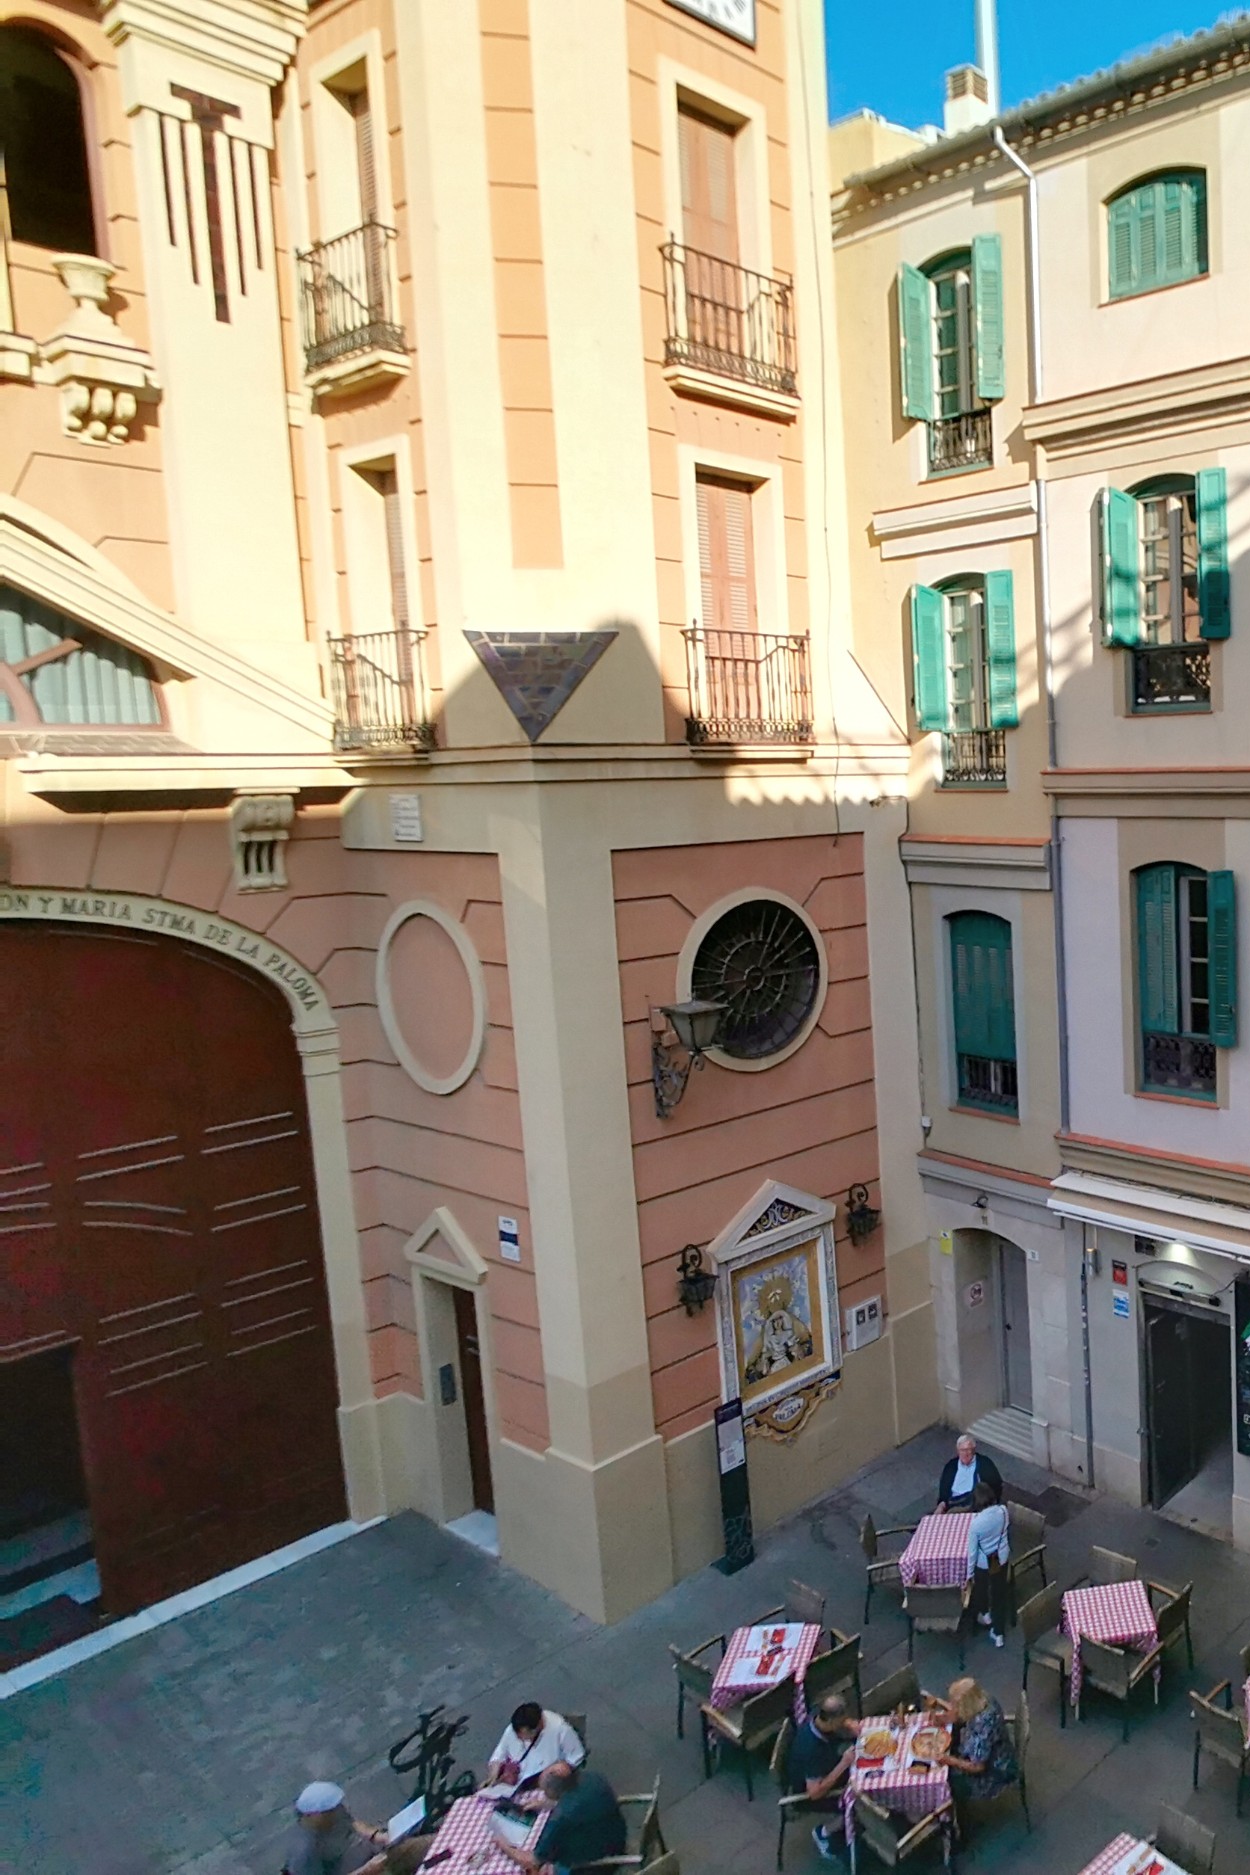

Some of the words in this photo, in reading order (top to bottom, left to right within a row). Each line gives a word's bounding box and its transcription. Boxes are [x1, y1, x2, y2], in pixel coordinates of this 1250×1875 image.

[38, 896, 54, 914] Y
[60, 897, 132, 921] MARIA
[142, 908, 197, 936] STMA
[202, 923, 234, 947] DE
[235, 936, 262, 960] LA
[263, 952, 320, 1012] PALOMA
